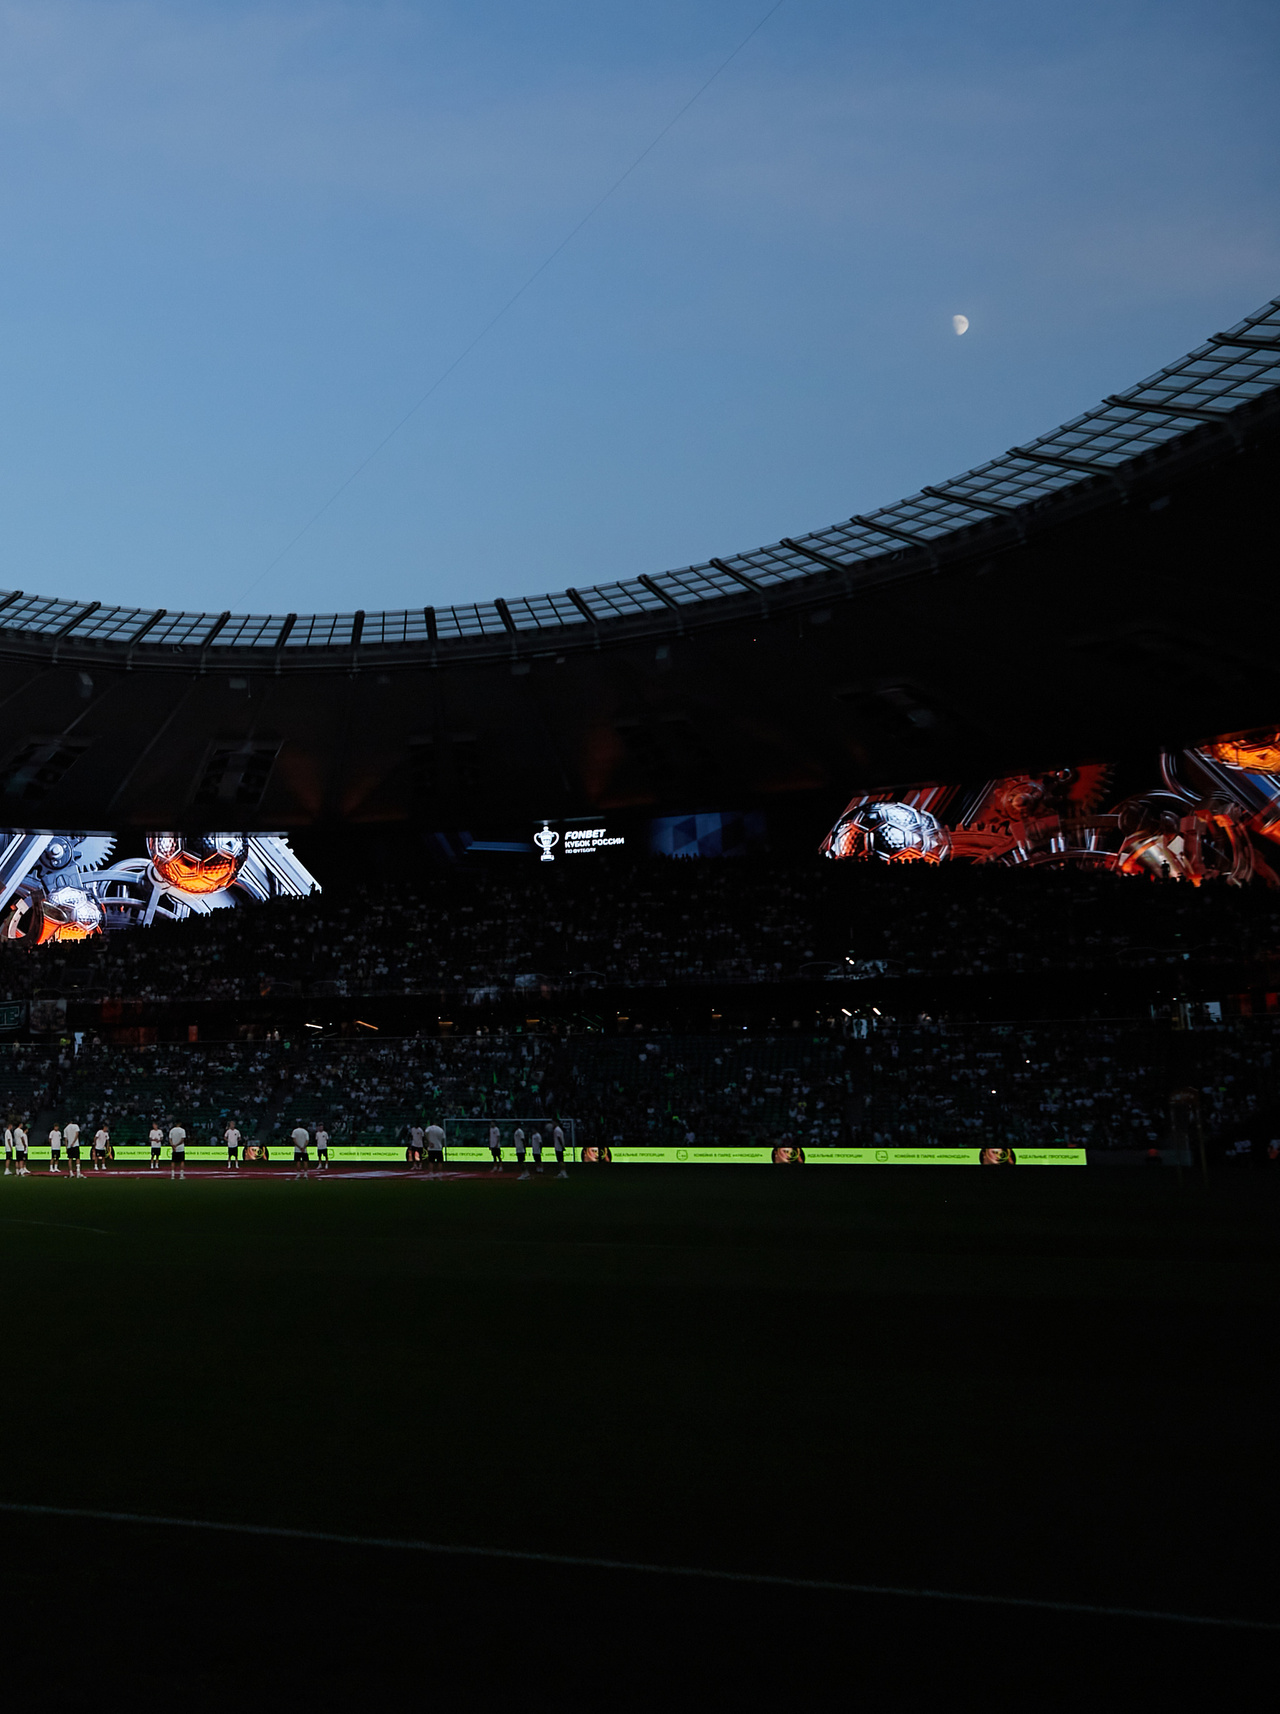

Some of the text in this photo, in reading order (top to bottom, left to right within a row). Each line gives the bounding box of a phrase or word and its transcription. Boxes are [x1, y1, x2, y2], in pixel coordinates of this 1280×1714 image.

[564, 829, 606, 840] FONBET
[564, 837, 625, 848] КУБОК РОССИИ
